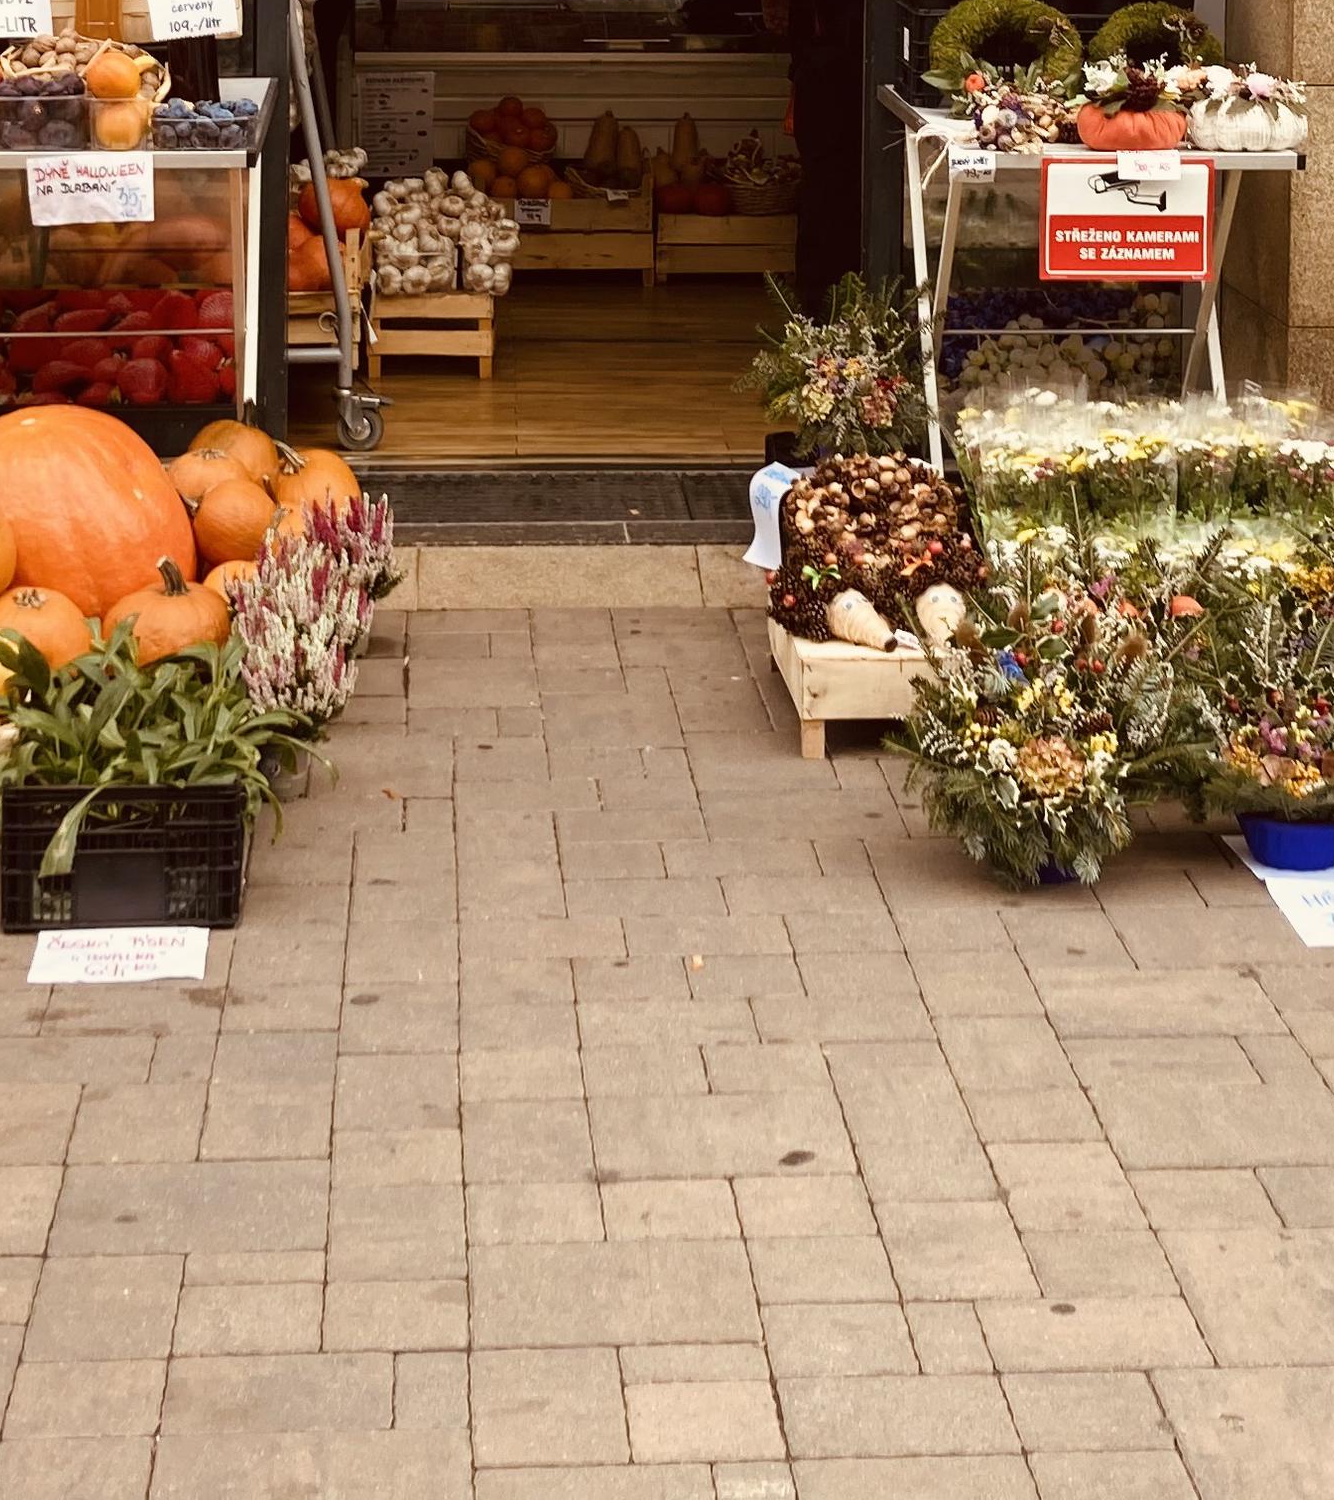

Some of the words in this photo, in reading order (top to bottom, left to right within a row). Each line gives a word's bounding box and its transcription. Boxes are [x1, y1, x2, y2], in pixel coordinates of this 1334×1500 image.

[75, 163, 146, 179] HALLOWEEN
[36, 185, 54, 196] NA
[1055, 227, 1122, 243] STŘEŽENO
[1126, 230, 1200, 243] KAMERAMI
[1079, 247, 1096, 261] SE
[1100, 245, 1175, 261] ZÁZNAMEM
